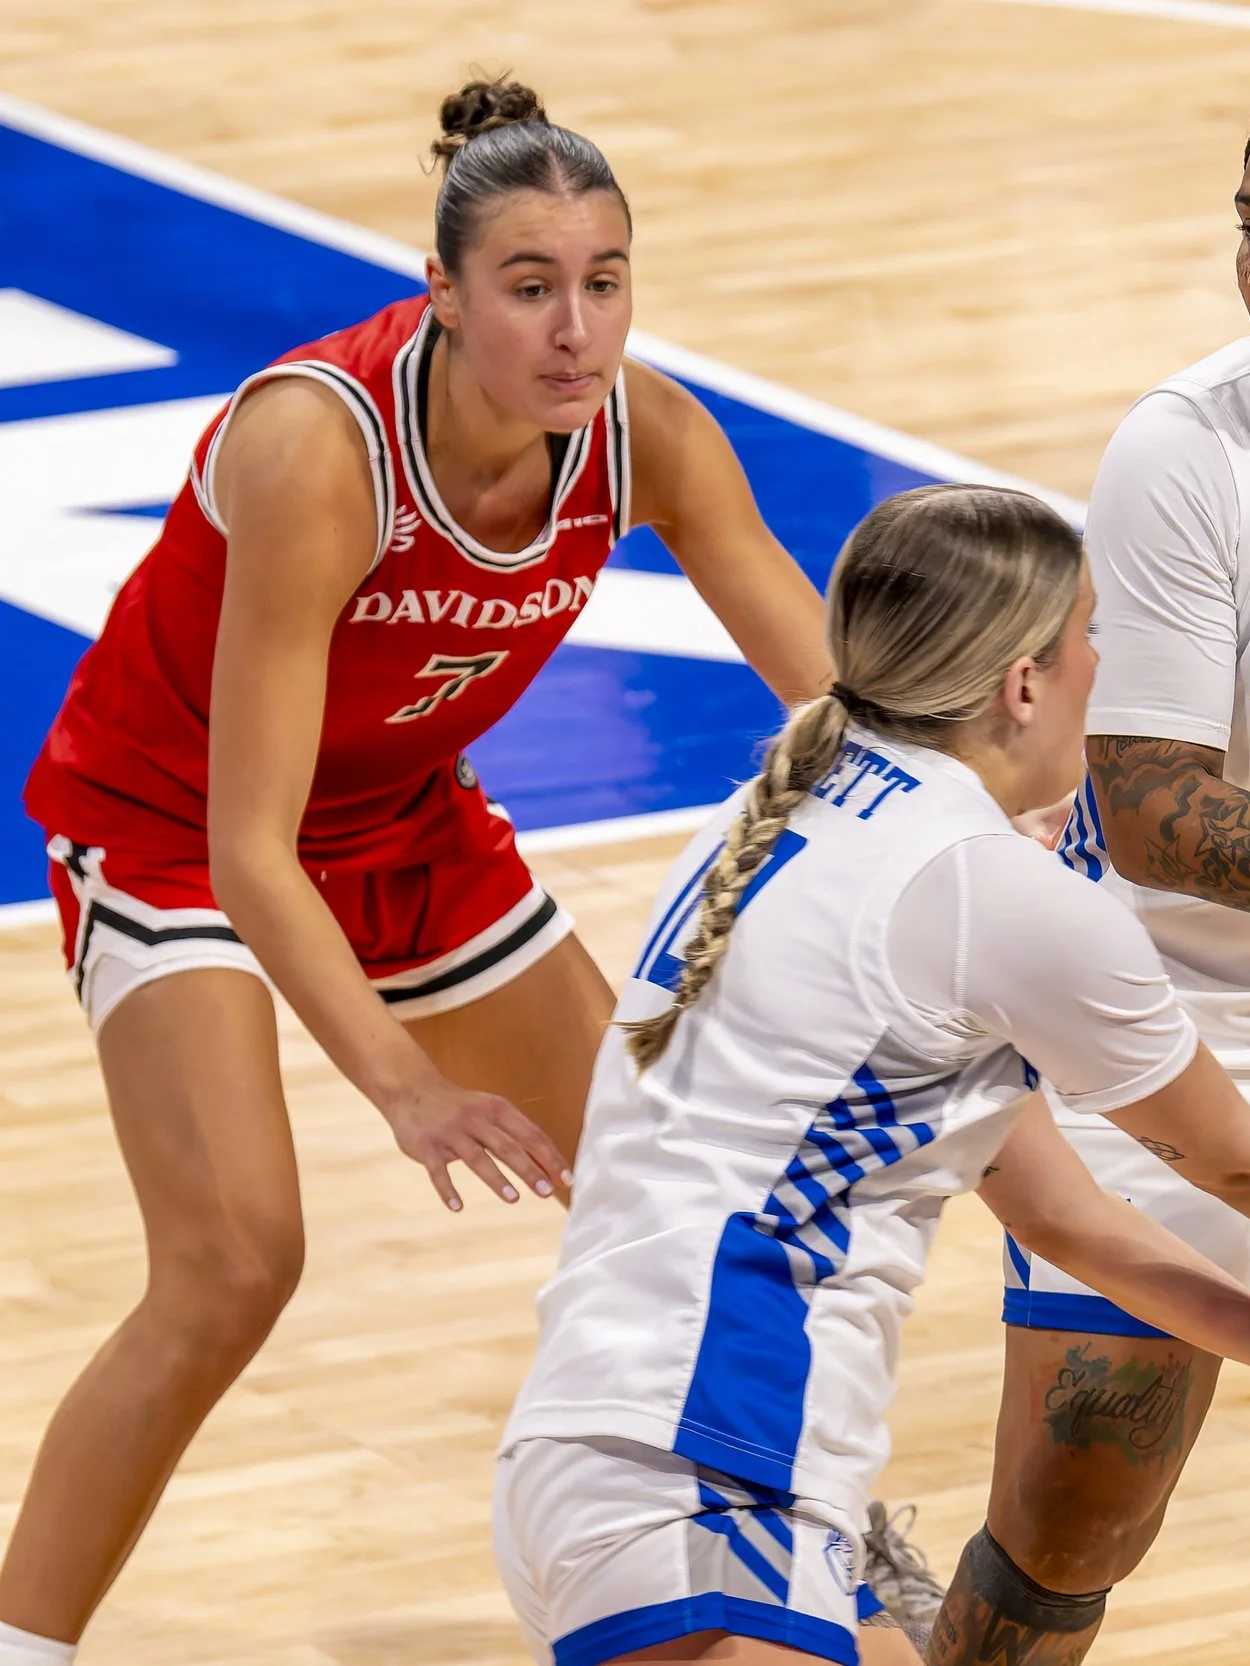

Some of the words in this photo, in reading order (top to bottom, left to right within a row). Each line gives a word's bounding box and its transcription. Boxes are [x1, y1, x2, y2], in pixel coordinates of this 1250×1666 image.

[350, 570, 602, 629] DAVIDSON
[384, 650, 510, 724] 7
[808, 740, 922, 820] ETT
